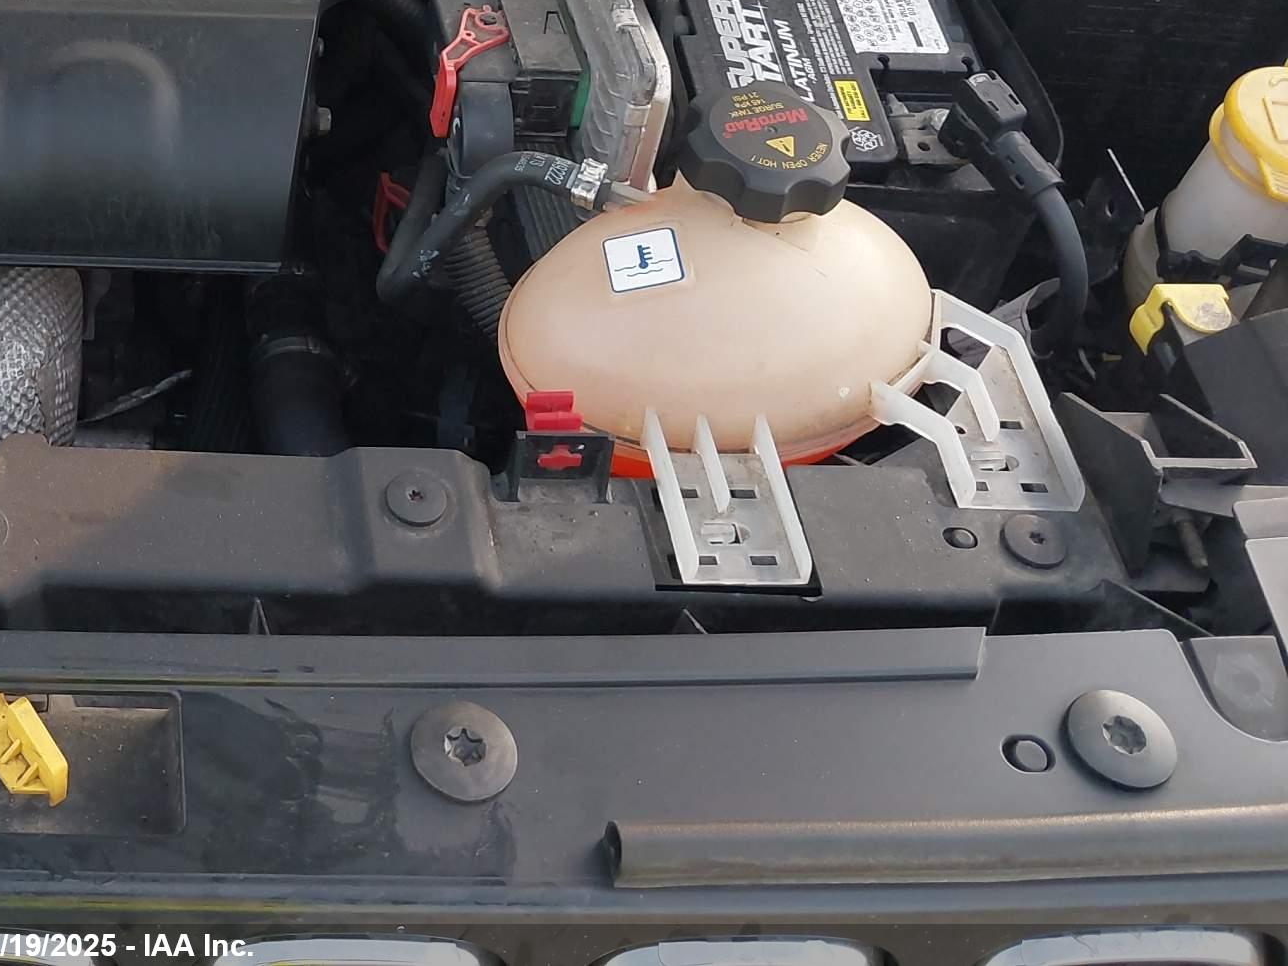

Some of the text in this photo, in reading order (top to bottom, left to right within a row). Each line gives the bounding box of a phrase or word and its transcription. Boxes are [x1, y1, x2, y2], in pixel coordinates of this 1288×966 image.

[773, 19, 815, 102] LATINUM
[731, 92, 748, 102] PSI
[728, 101, 784, 118] SURGE TANK
[807, 142, 828, 162] NEVER
[757, 157, 777, 168] HOT
[781, 159, 808, 169] OPEN
